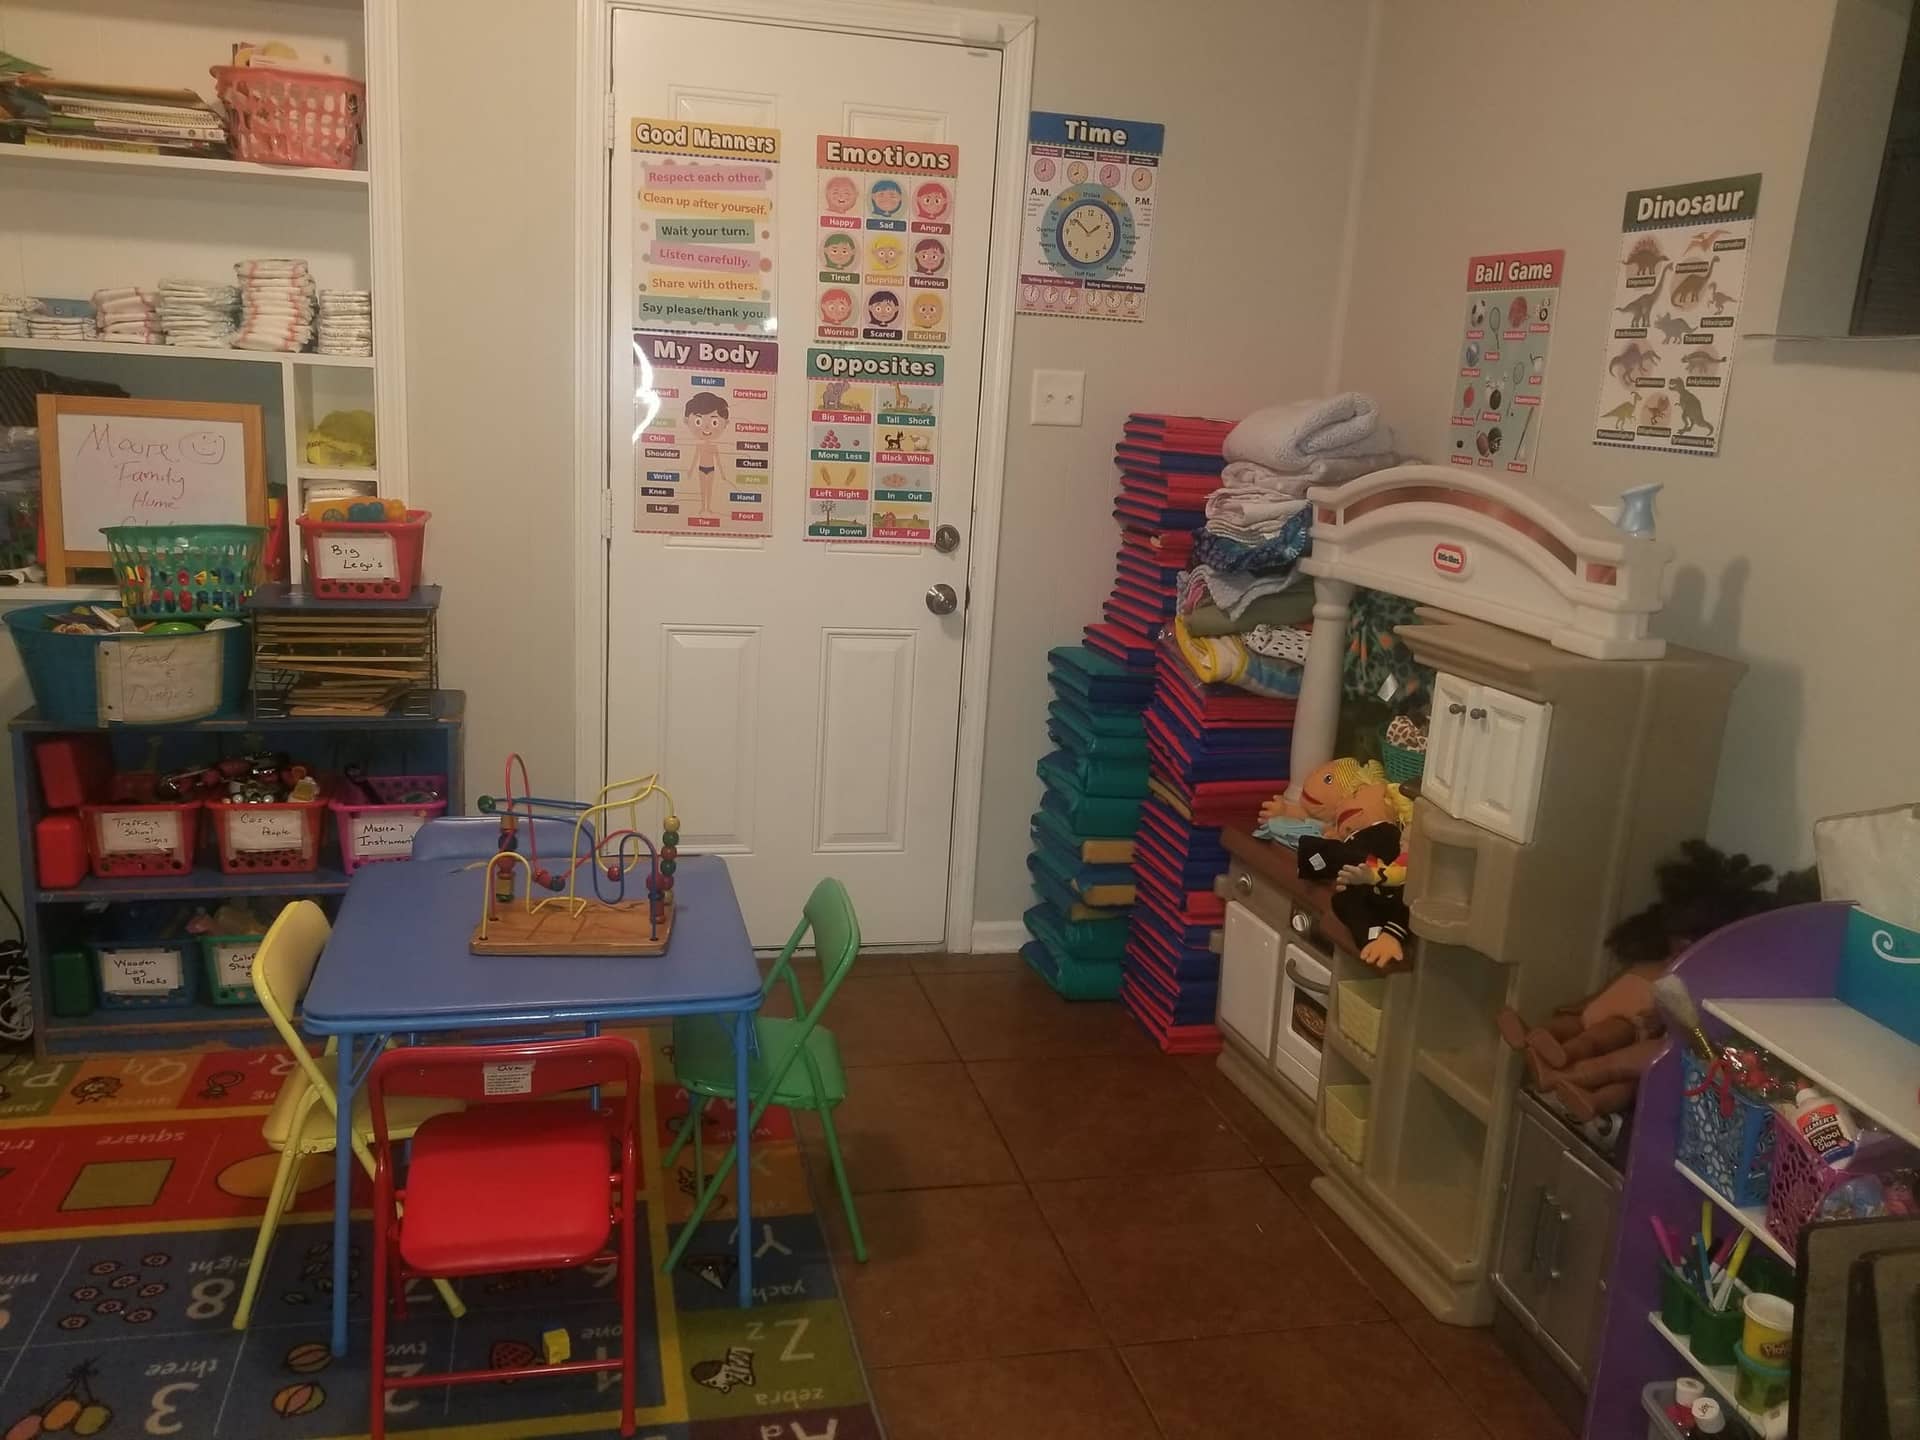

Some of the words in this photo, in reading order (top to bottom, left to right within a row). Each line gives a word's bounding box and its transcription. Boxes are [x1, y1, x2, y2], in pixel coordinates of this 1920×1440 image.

[636, 124, 688, 146] Good
[693, 128, 775, 153] Manners
[1065, 120, 1127, 145] Time
[826, 141, 950, 170] Emotions
[649, 172, 694, 184] Respect
[698, 173, 724, 183] each
[728, 173, 761, 183] other.
[1031, 188, 1051, 196] A.M.
[643, 192, 674, 205] Clean
[676, 198, 690, 208] up
[693, 199, 718, 210] after
[722, 203, 767, 217] yourself.
[1135, 197, 1152, 206] P.M.
[1637, 190, 1744, 221] Dinosaur
[830, 218, 854, 228] Happy
[920, 224, 943, 234] Angry
[661, 226, 688, 237] Wait
[692, 227, 718, 239] your
[722, 226, 749, 236] turn.
[660, 249, 694, 262] Listen
[698, 254, 750, 268] carefully.
[1475, 262, 1504, 283] Ball
[1509, 261, 1553, 281] Game
[652, 279, 684, 289] Share
[689, 279, 714, 289] with
[723, 281, 758, 291] others.
[914, 279, 945, 287] Nervous
[642, 303, 663, 315] Say
[666, 305, 739, 318] please/thank
[743, 310, 767, 320] you.
[824, 328, 855, 336] Worried
[870, 330, 896, 338] Scared
[654, 340, 691, 364] My
[700, 343, 759, 368] Body
[815, 353, 936, 376] Opposites
[734, 390, 767, 399] Forehead
[822, 414, 835, 422] Big
[842, 414, 865, 422] Small
[908, 417, 930, 425] Short
[818, 452, 839, 460] More
[846, 452, 862, 460] Less
[881, 454, 902, 462] Black
[838, 490, 860, 499] Right
[887, 492, 896, 500] In
[655, 505, 668, 513] Leg
[331, 543, 360, 558] Big
[114, 960, 157, 968] Wooden
[125, 969, 146, 977] Log
[96, 1129, 185, 1146] square
[1813, 1130, 1841, 1147] School
[752, 1280, 806, 1303] yach
[186, 1277, 235, 1320] 8
[144, 1359, 218, 1378] three
[753, 1387, 826, 1409] zebra
[145, 1382, 199, 1436] 3
